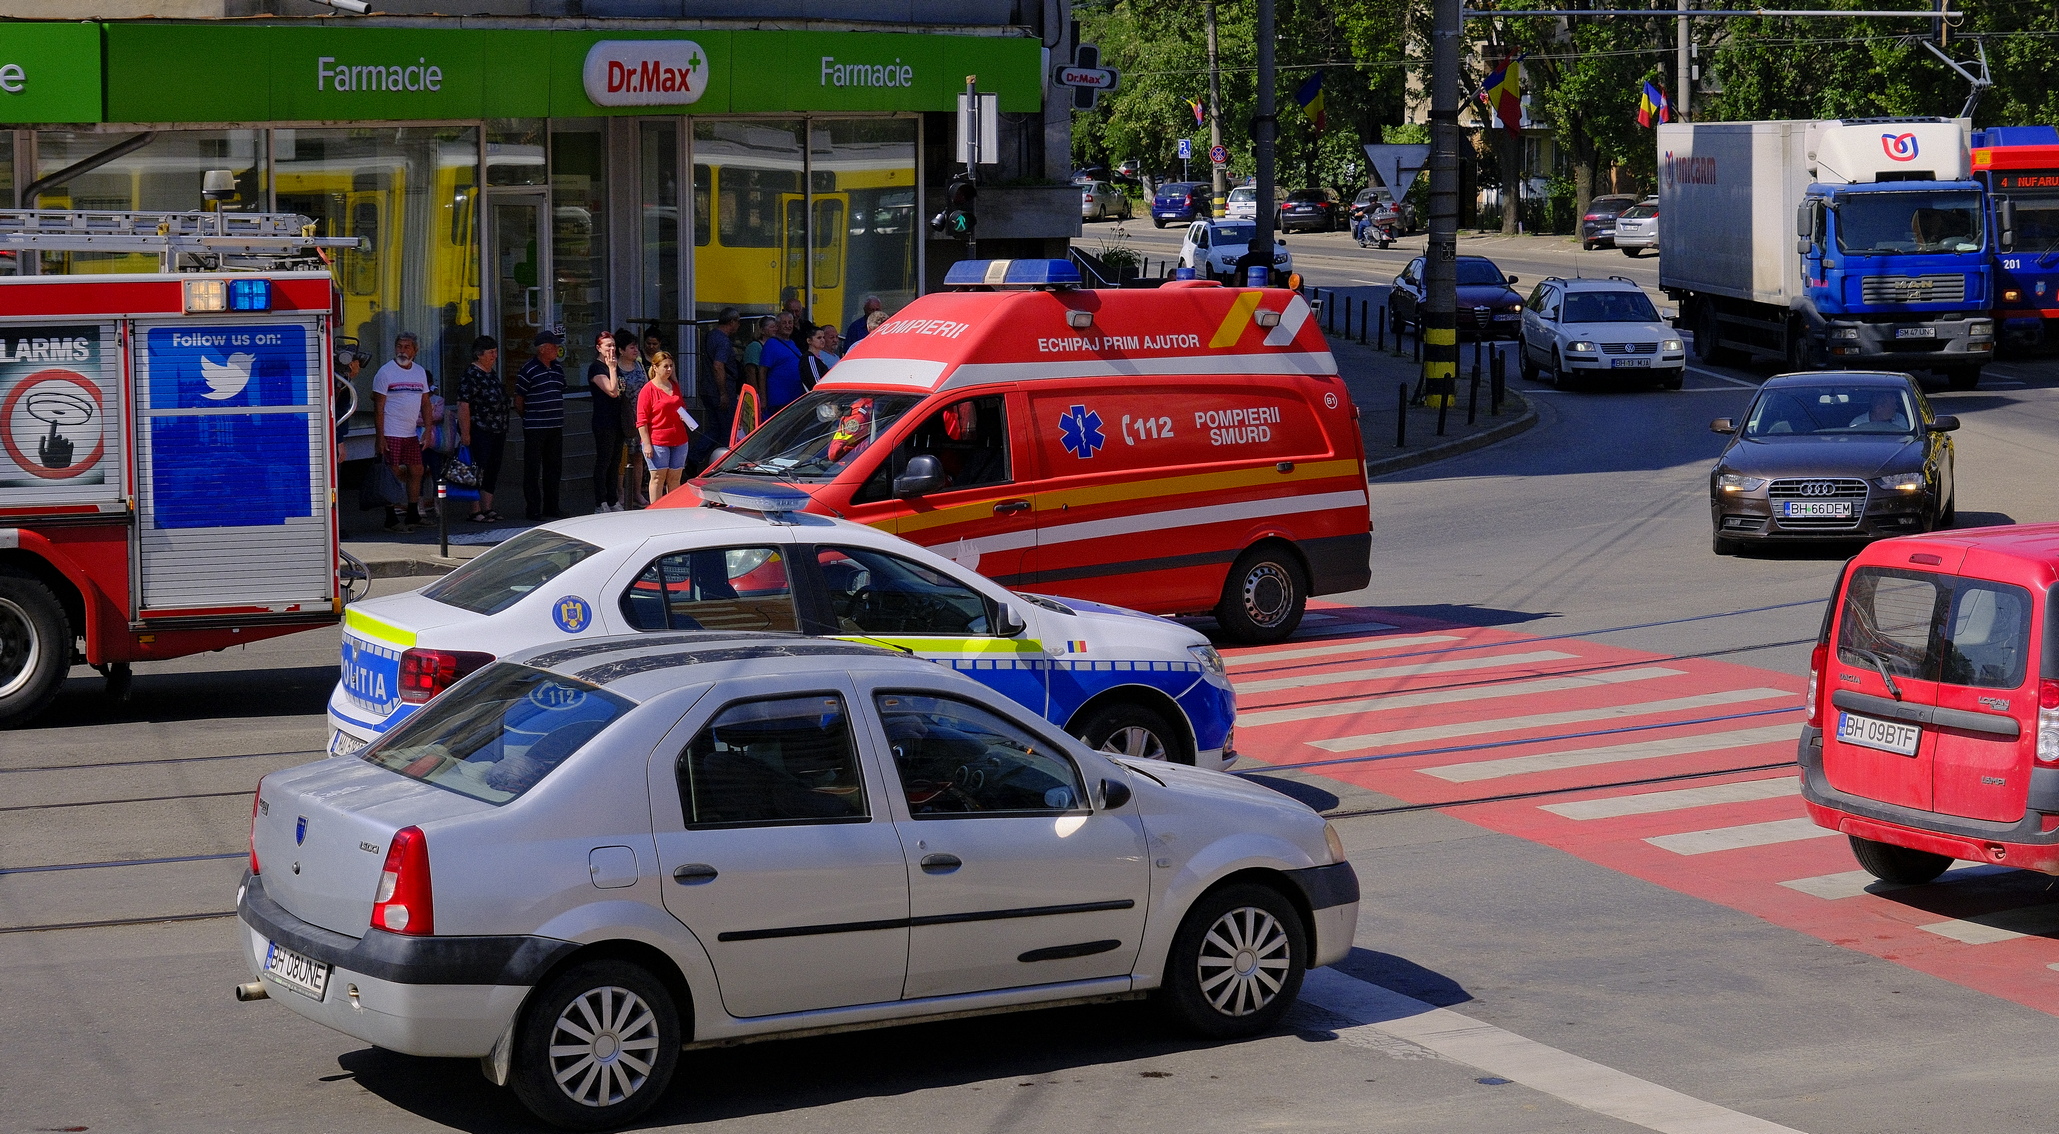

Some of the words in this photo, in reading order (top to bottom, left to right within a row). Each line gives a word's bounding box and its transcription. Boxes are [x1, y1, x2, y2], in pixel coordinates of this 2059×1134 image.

[318, 57, 442, 92] Farmacie
[607, 60, 691, 93] Dr.Max
[821, 56, 913, 88] Farmacie
[1066, 72, 1101, 84] Dr.Max
[2001, 177, 2009, 188] 4
[2017, 176, 2059, 188] NUFARU
[2003, 259, 2021, 270] 201
[870, 319, 970, 339] POMPIERII
[173, 333, 226, 347] Follow
[231, 334, 251, 346] us
[255, 333, 282, 346] on:
[1037, 337, 1100, 352] ECHIPAJ
[1103, 335, 1140, 350] PRIM
[1143, 333, 1200, 349] AJUTOR
[1326, 396, 1337, 406] B1
[1194, 406, 1281, 428] POMPIERII
[1134, 416, 1174, 440] 112
[1210, 426, 1271, 446] SMURD
[1791, 503, 1808, 514] BH
[549, 690, 575, 705] 112
[1978, 696, 2011, 707] LOGAN
[1845, 717, 1864, 739] BH
[1868, 721, 1916, 748] 09BTF
[269, 945, 285, 974] BH
[286, 950, 326, 990] 08UNE
